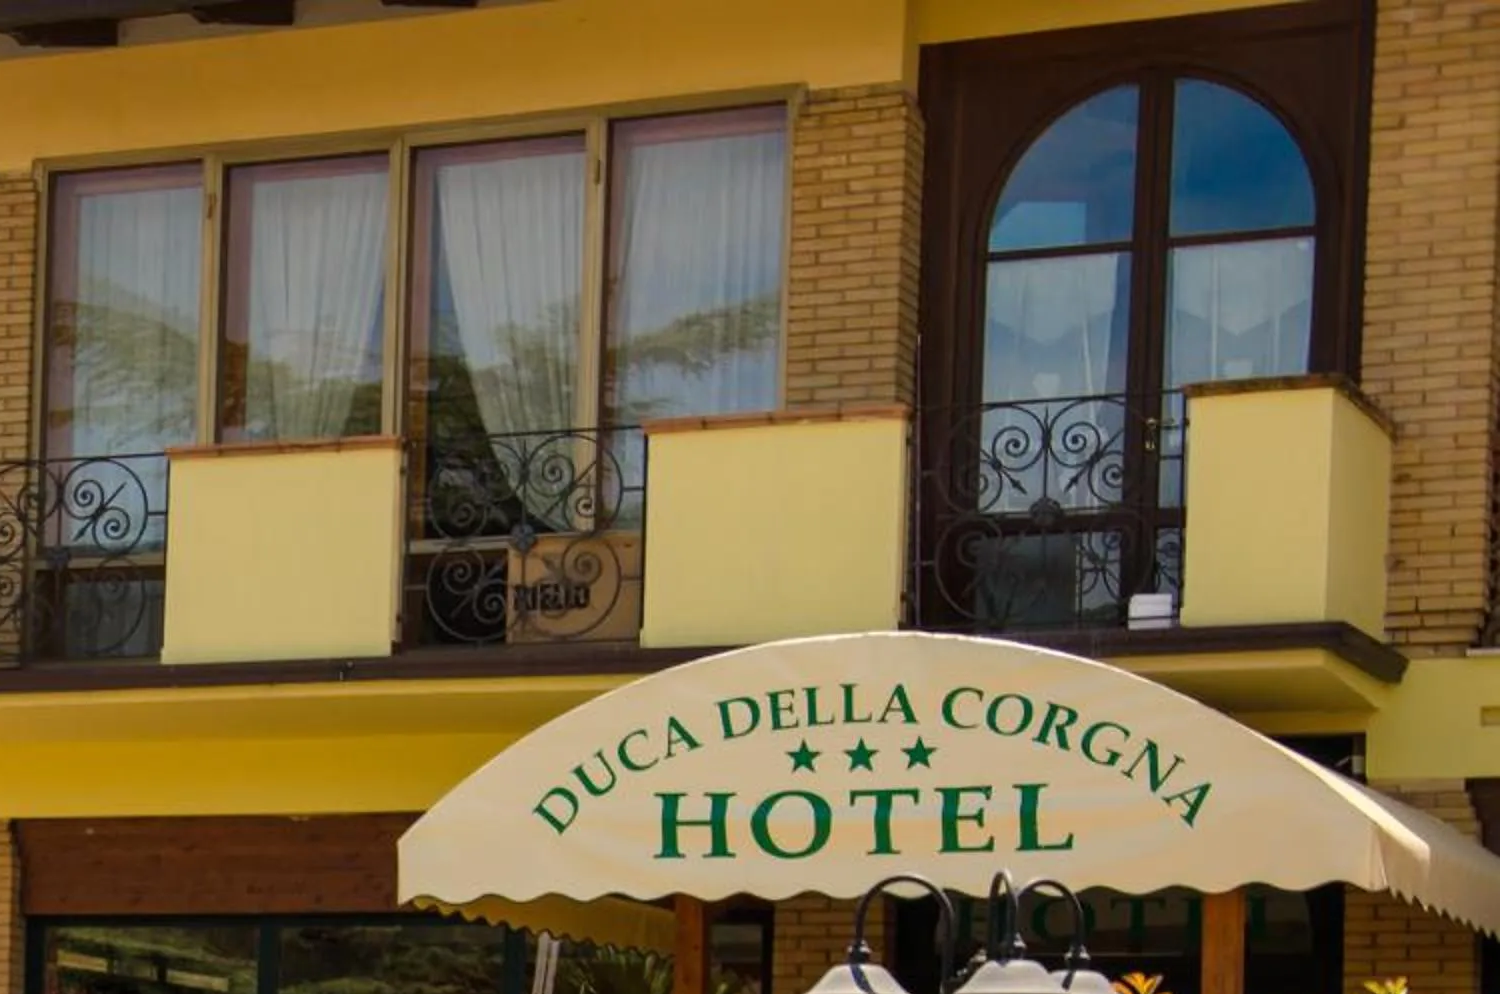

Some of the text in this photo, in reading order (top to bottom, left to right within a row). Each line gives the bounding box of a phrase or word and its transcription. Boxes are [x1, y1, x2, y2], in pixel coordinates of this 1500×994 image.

[532, 682, 1213, 836] DUCA DELLA CORGNA
[652, 783, 1075, 860] HOTEL
